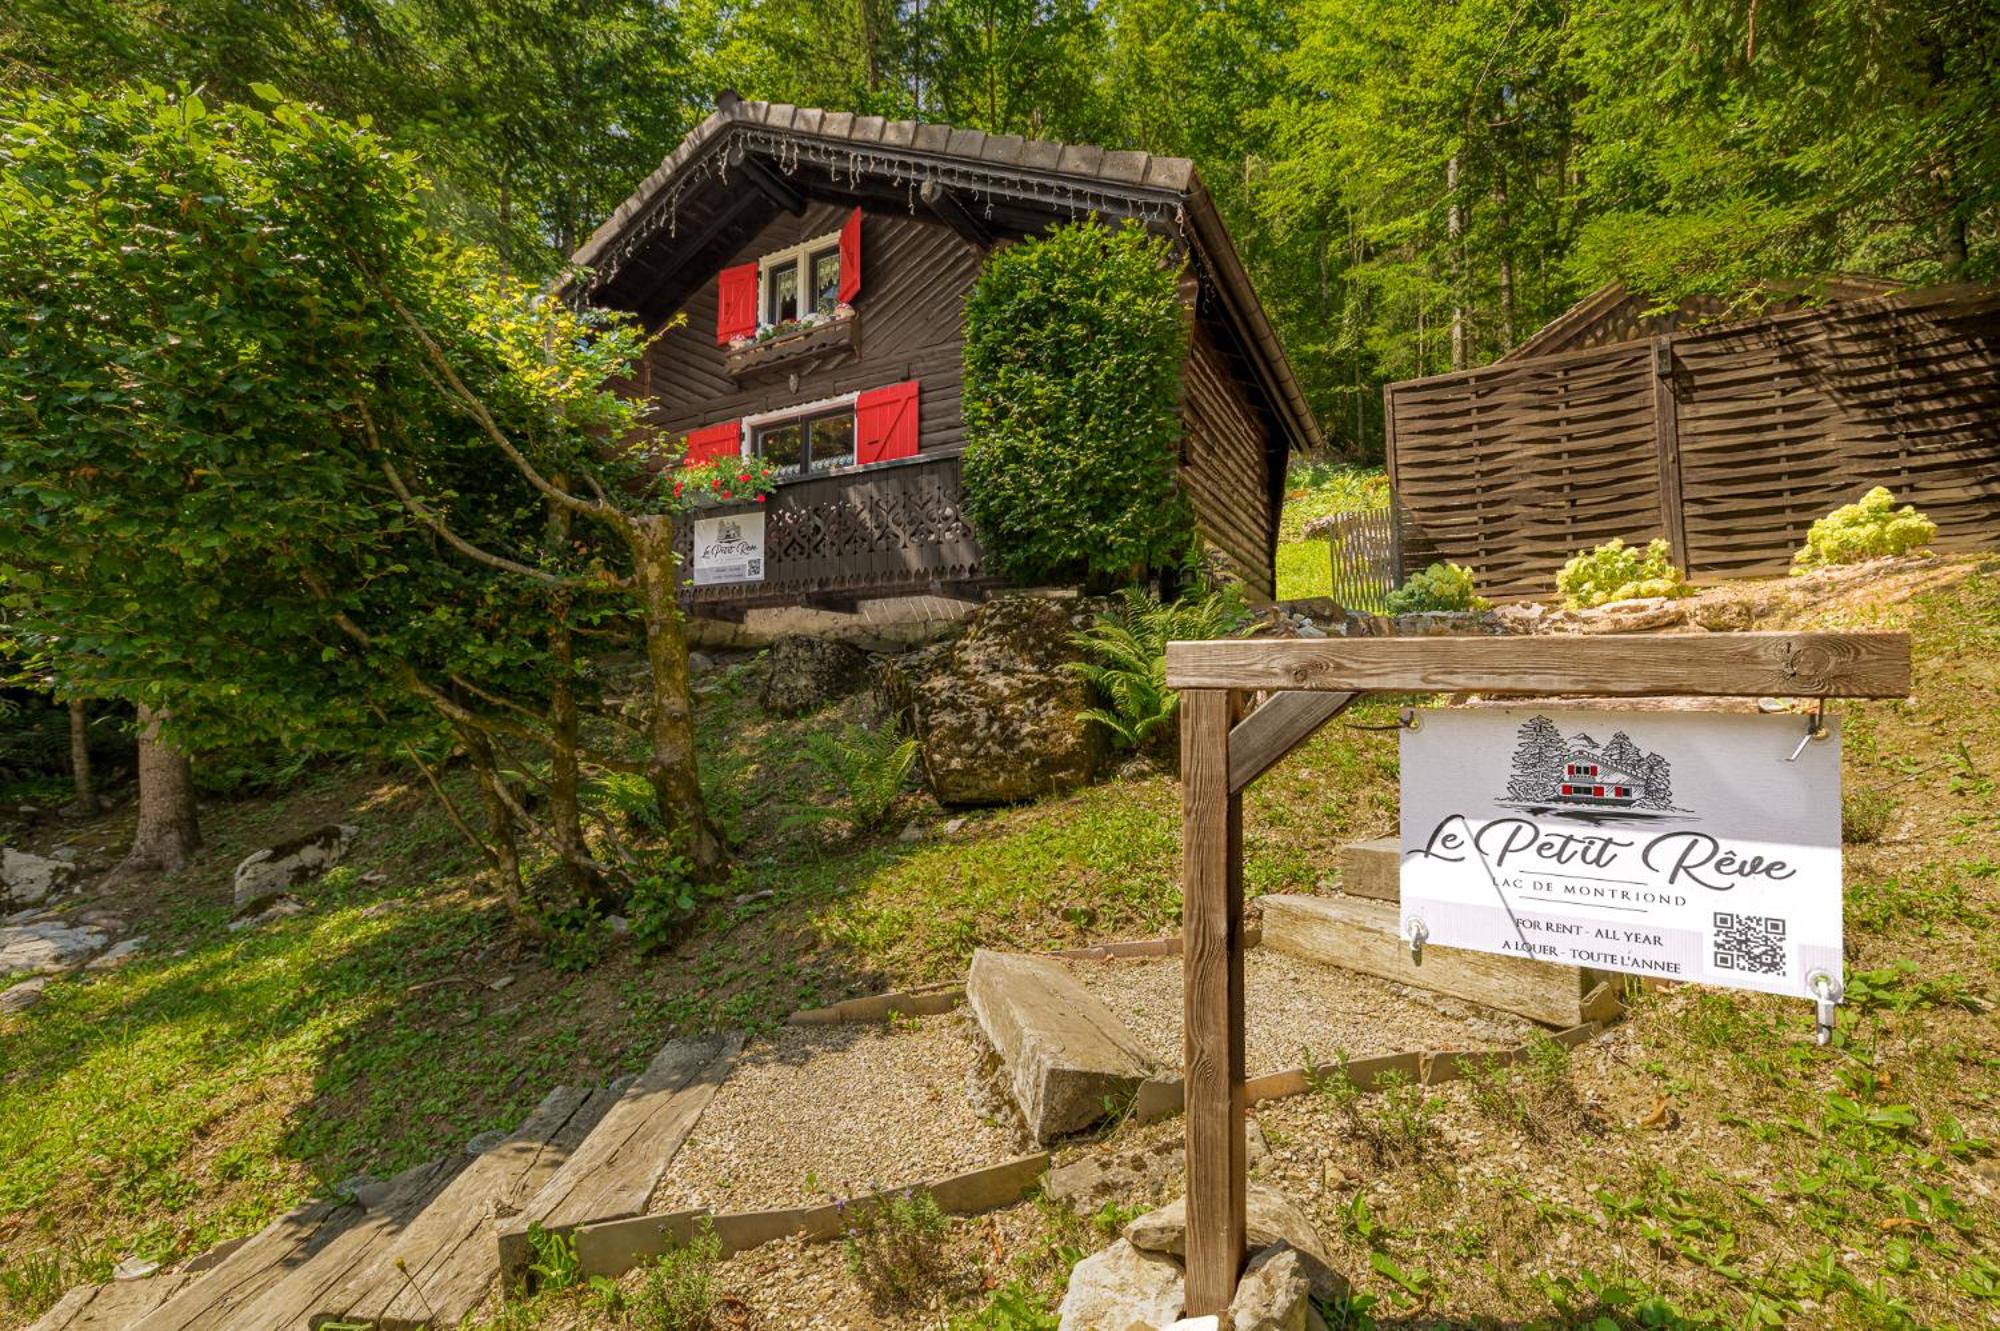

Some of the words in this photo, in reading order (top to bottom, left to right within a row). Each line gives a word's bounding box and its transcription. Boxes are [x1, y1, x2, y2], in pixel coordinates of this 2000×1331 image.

[1406, 814, 1465, 862] Le
[1474, 818, 1632, 868] Petit
[1641, 831, 1796, 891] Rêve
[1492, 876, 1523, 889] LAC
[1532, 880, 1553, 892] DE
[1563, 884, 1686, 906] MONTRIOND
[1515, 918, 1542, 931] FOR
[1545, 922, 1583, 935] RENT
[1594, 928, 1620, 941] ALL
[1623, 931, 1663, 946] YEAR
[1502, 940, 1511, 950] A
[1515, 941, 1559, 957] LOUER
[1569, 949, 1618, 965] TOUTE
[1620, 955, 1681, 974] L'ANNEE
